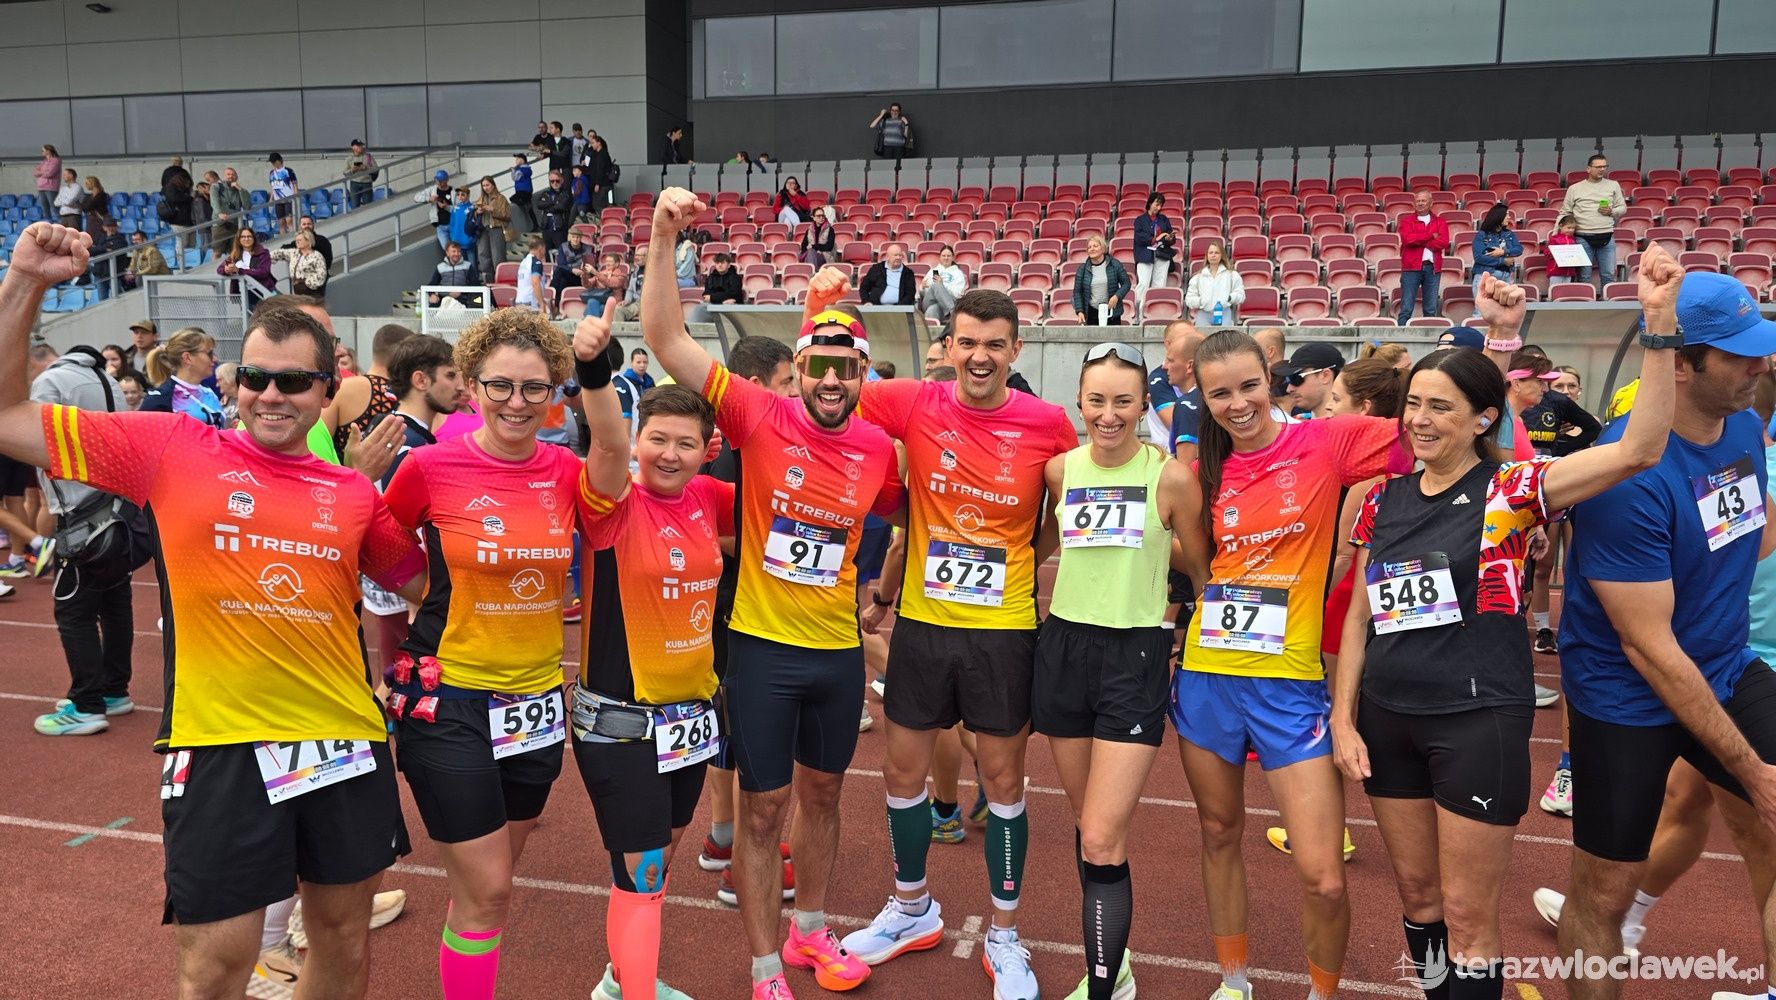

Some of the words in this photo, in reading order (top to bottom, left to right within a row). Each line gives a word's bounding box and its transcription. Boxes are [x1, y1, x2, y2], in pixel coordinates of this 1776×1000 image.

[950, 482, 1019, 506] TREBUD
[1717, 485, 1745, 520] 43
[793, 501, 855, 527] TREBUD
[1074, 504, 1127, 529] 671
[246, 533, 341, 562] TREBUD
[503, 548, 572, 560] TREBUD
[790, 540, 823, 568] 91
[682, 577, 720, 594] TREBU
[936, 560, 993, 588] 672
[475, 602, 501, 611] KUBA
[1379, 575, 1439, 611] 548
[1221, 604, 1260, 631] 87
[665, 640, 688, 648] KUBA
[504, 697, 556, 735] 595
[669, 715, 712, 752] 268
[1096, 899, 1104, 964] COMPRESSPORT
